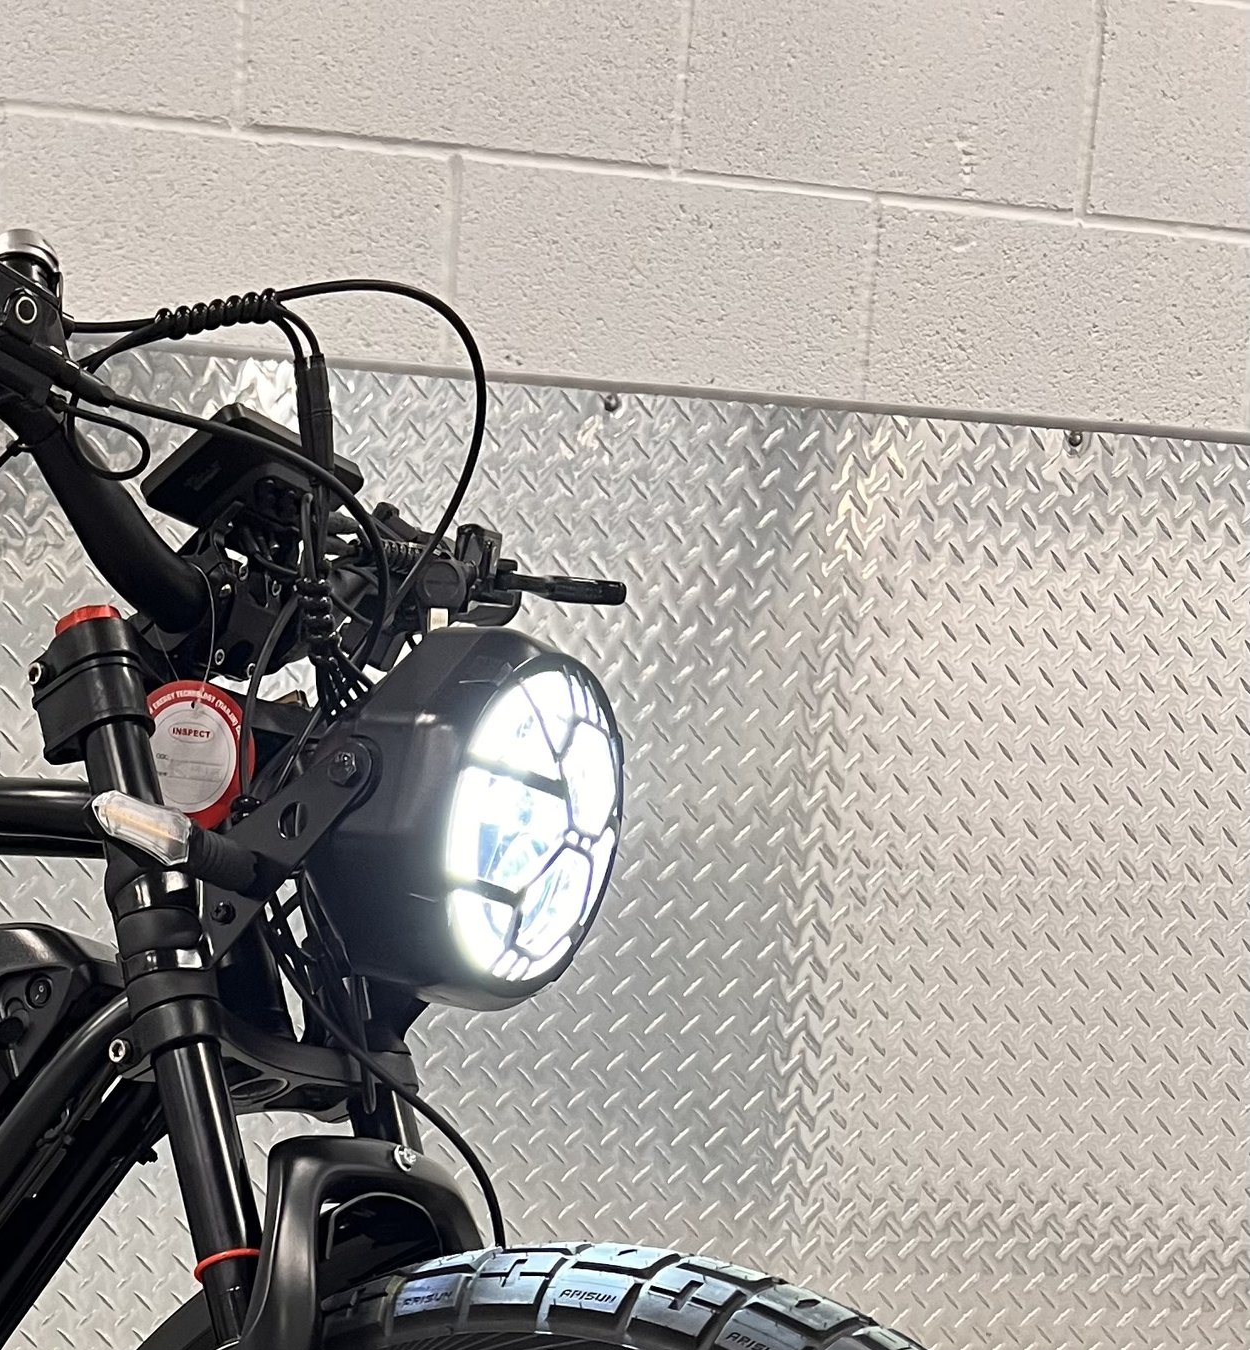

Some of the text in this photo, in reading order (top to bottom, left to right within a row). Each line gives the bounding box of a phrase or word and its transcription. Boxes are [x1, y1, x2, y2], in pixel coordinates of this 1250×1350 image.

[173, 727, 211, 739] INSPECT
[403, 1291, 453, 1306] ARISUN
[559, 1288, 618, 1304] ARISUN
